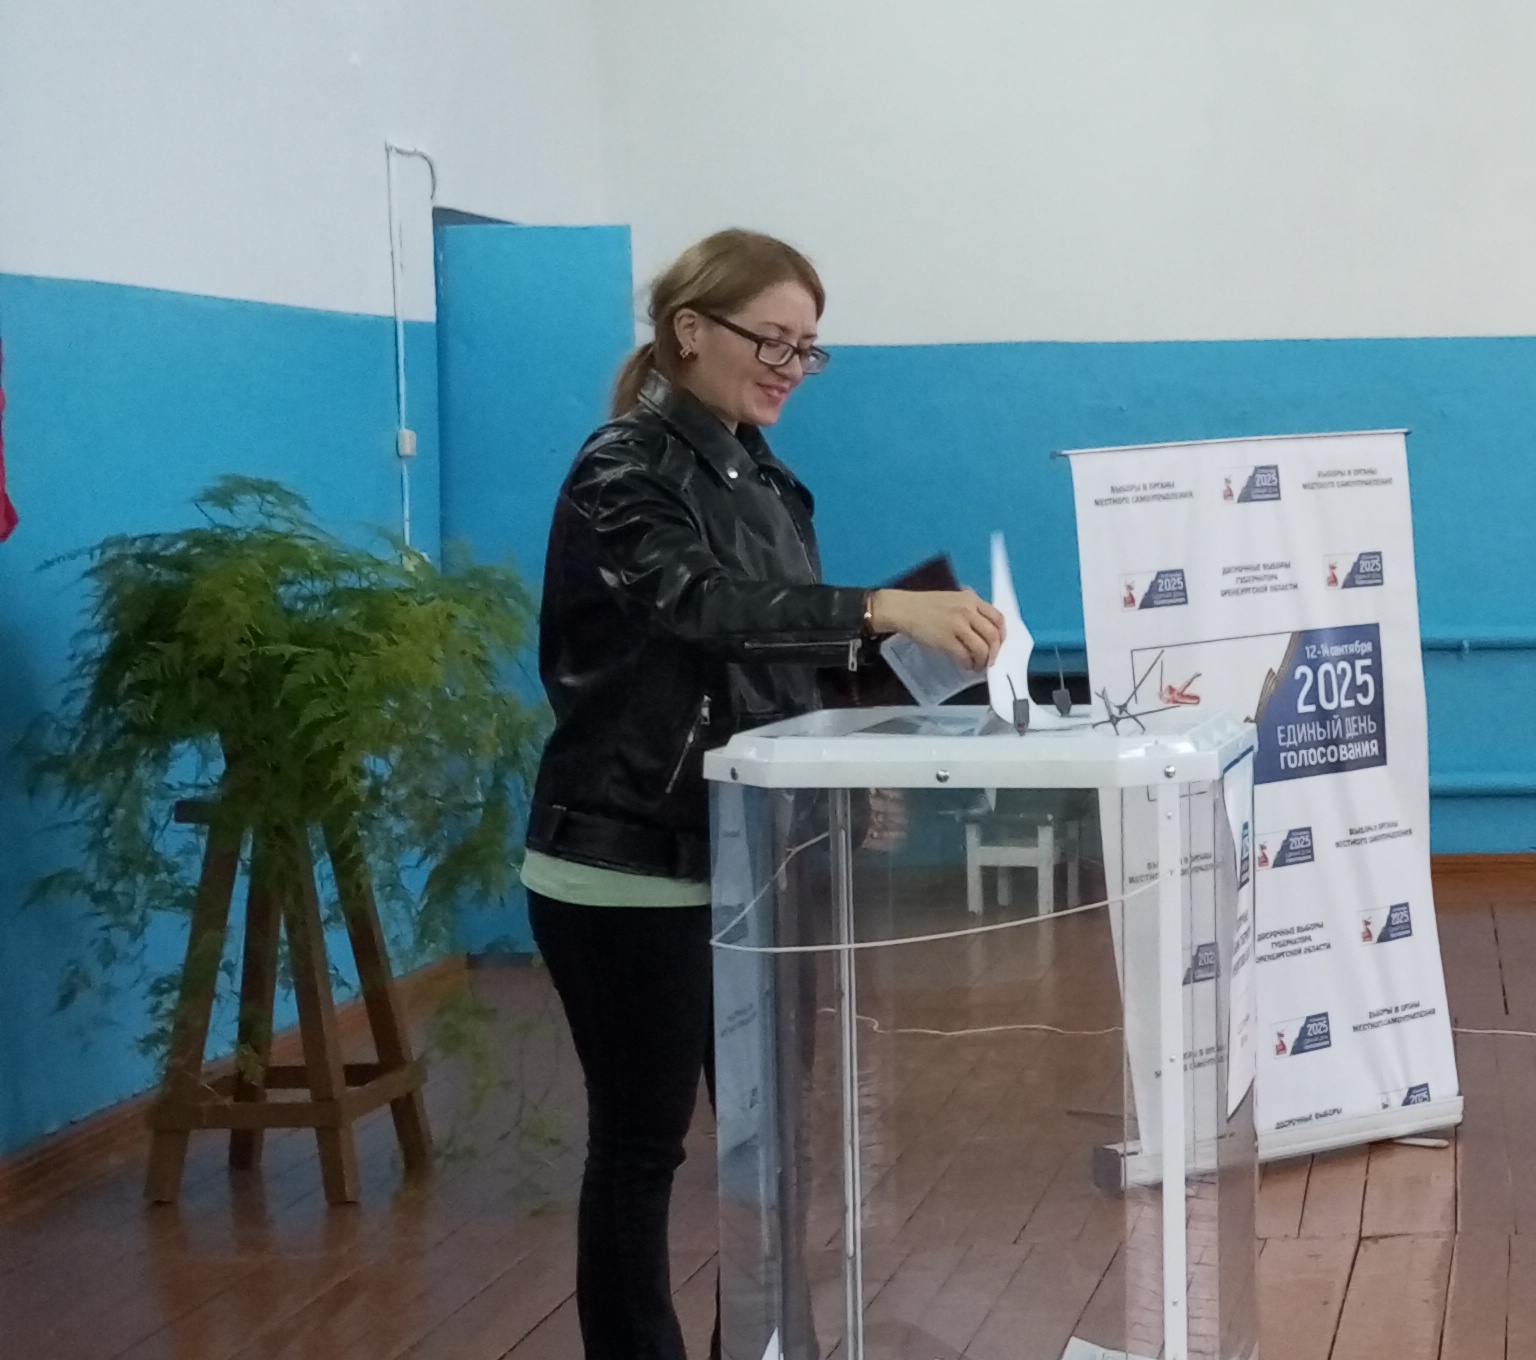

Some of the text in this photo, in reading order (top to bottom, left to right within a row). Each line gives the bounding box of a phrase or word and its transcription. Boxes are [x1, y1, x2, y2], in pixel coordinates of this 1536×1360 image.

[1158, 576, 1184, 592] 2025
[1330, 640, 1372, 656] сентября
[1294, 658, 1375, 714] 2025
[1276, 714, 1377, 748] ЕДИНЫЙ ДЕНЬ
